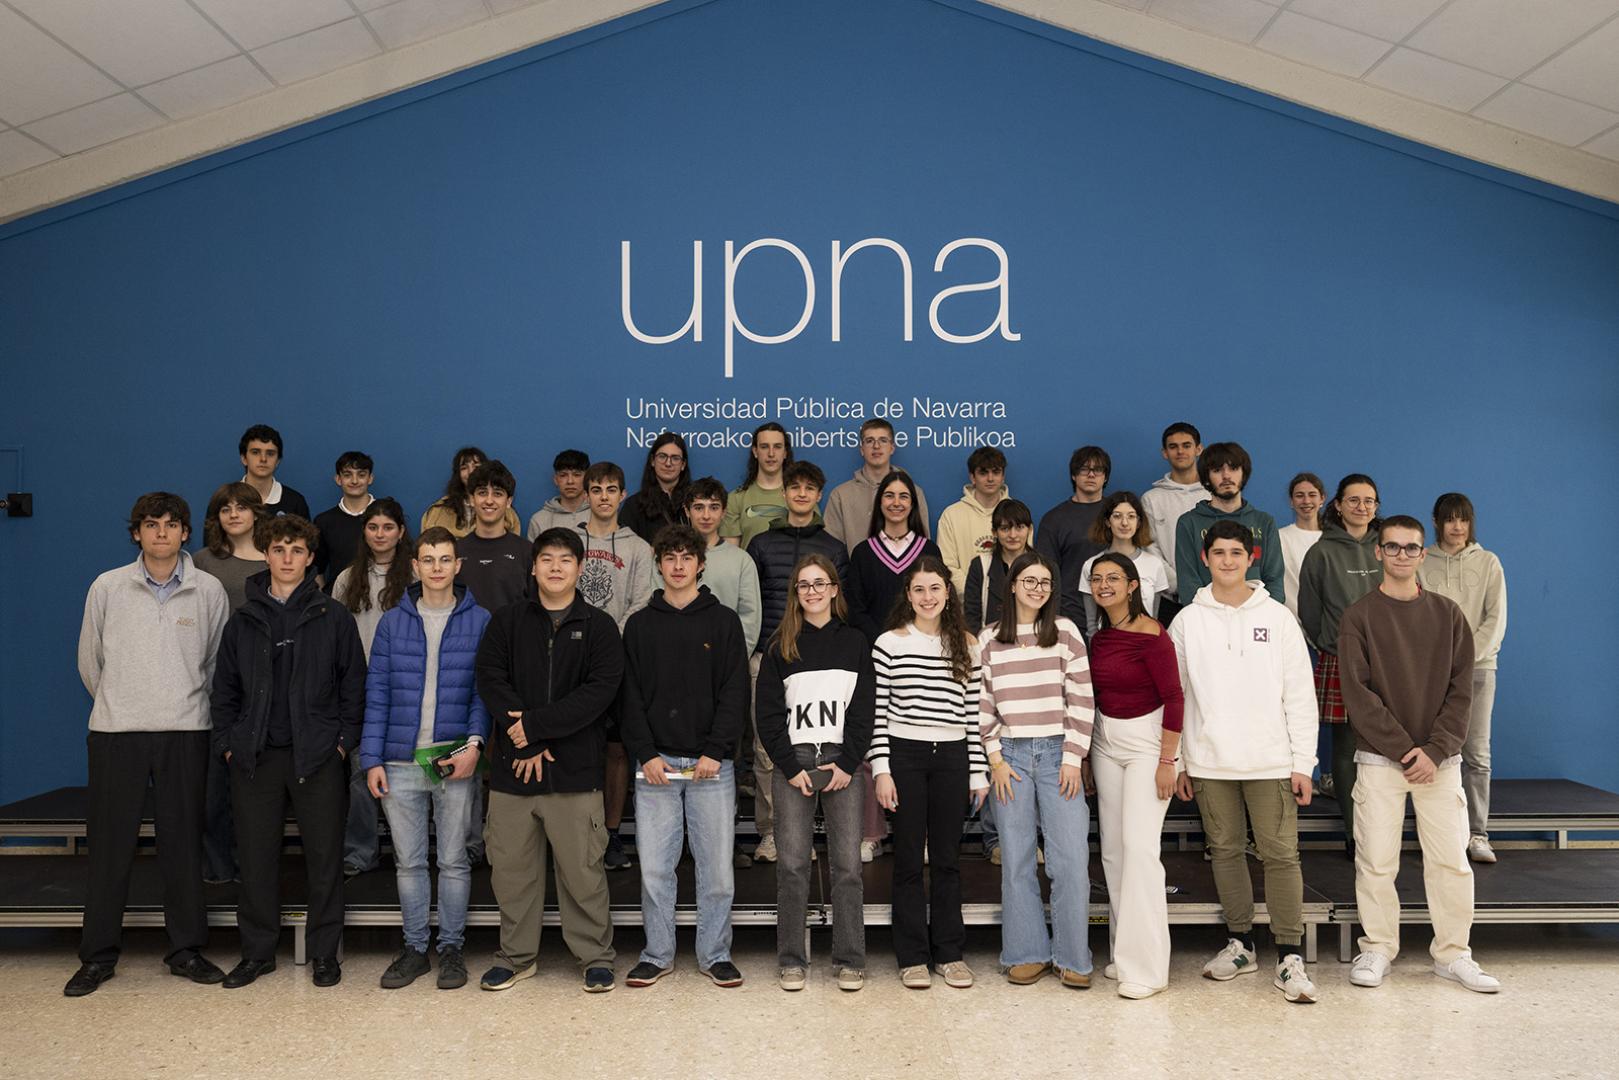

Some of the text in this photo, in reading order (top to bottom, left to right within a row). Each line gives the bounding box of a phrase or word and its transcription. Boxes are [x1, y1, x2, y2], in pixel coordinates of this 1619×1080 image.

[621, 238, 1021, 378] upna
[626, 396, 1007, 419] Universidad Pública de Navarra
[626, 426, 1016, 448] Narroako nibertse Publikoa
[786, 700, 847, 730] KN
